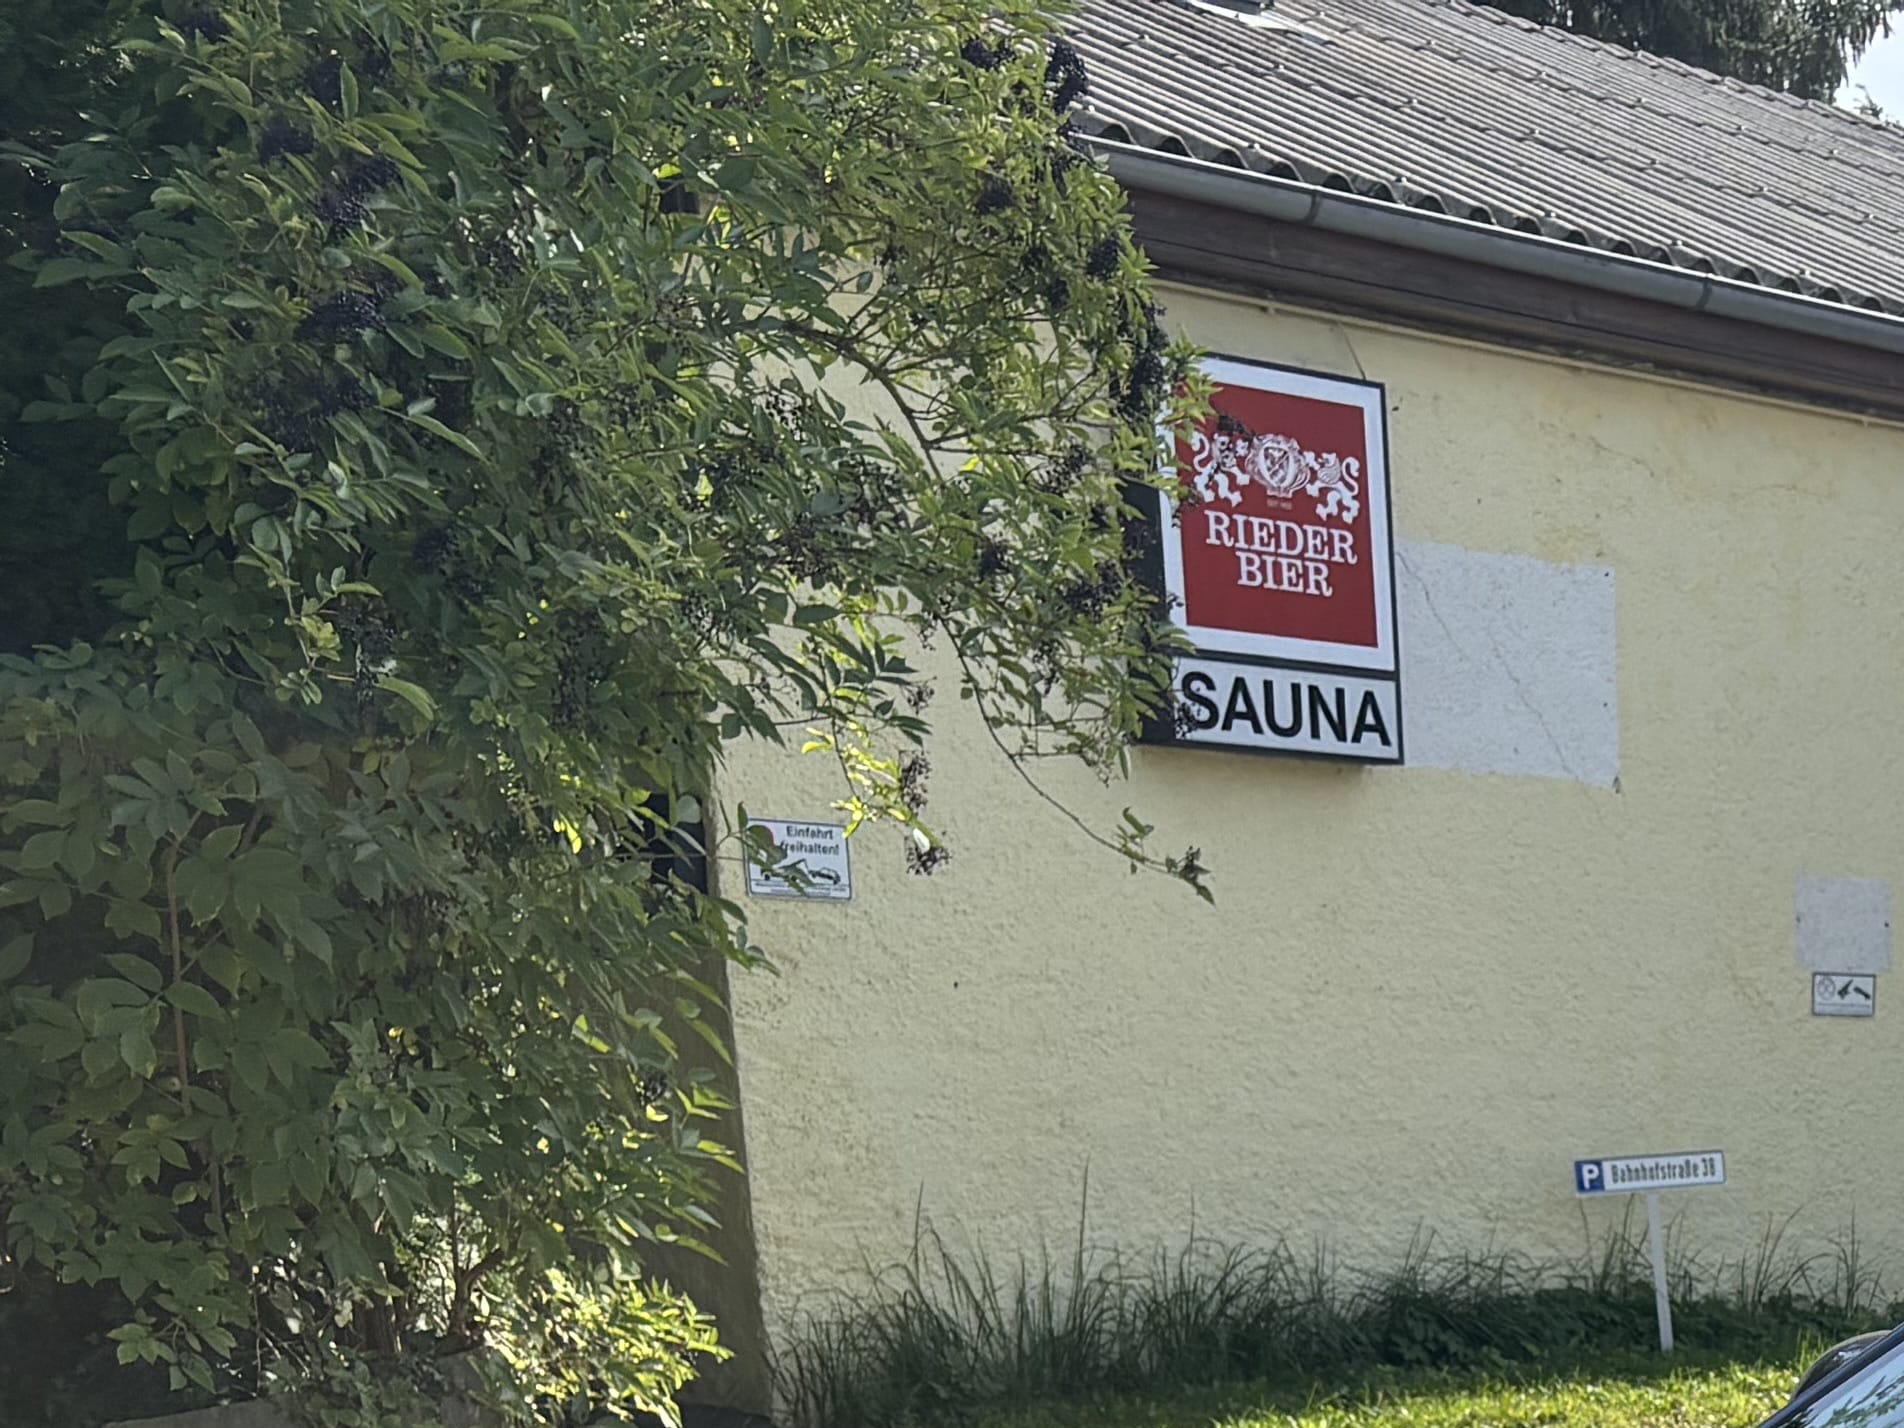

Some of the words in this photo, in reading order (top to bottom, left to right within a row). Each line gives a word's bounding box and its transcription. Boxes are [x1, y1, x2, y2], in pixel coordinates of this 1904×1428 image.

[1204, 510, 1358, 566] RIEDER
[1235, 549, 1334, 598] BIER
[1179, 670, 1392, 748] SAUNA
[786, 825, 834, 841] Einfahrt
[1581, 1163, 1599, 1190] P
[1610, 1159, 1699, 1185] Bahnhofstraße
